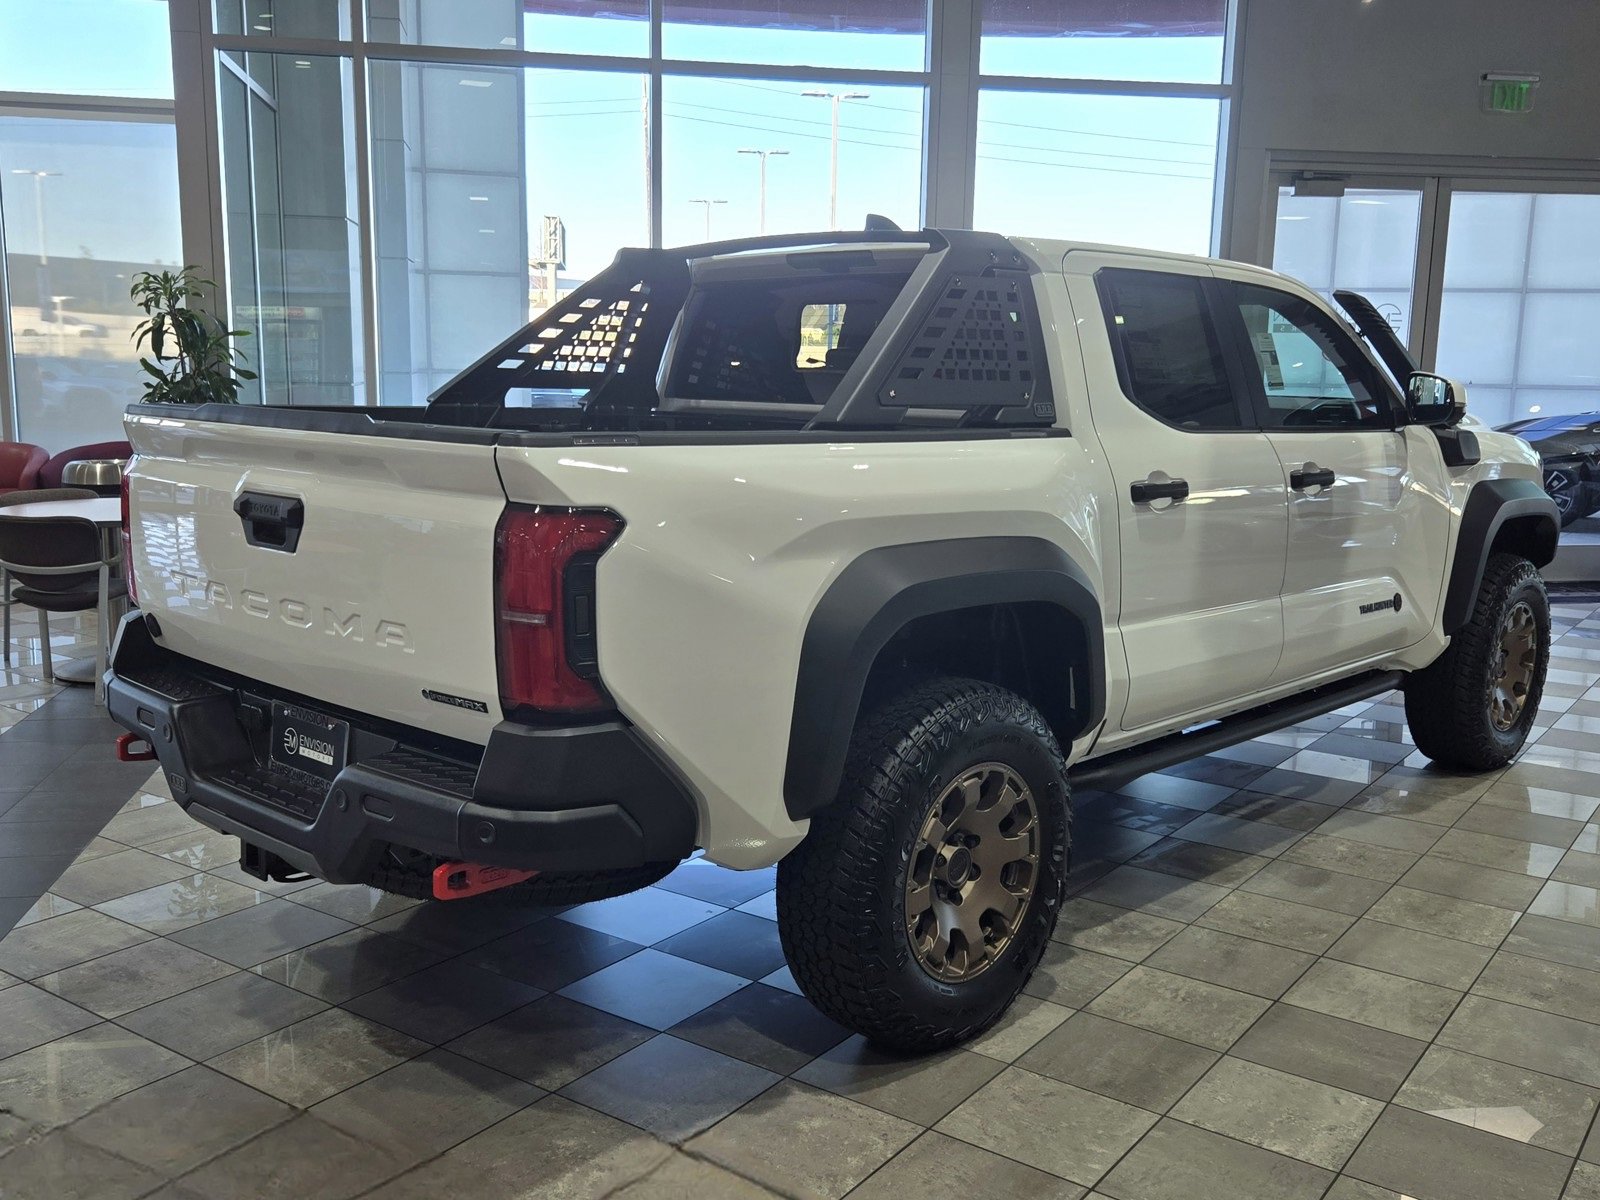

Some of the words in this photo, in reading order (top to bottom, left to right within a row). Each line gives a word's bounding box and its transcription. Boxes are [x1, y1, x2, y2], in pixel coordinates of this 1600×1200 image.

[1493, 82, 1529, 111] EXIT
[249, 502, 280, 517] TOYOTA
[170, 569, 415, 654] TACOMA
[291, 706, 328, 728] ENVISION
[299, 734, 335, 756] ENVISION
[300, 748, 332, 764] MOTORS
